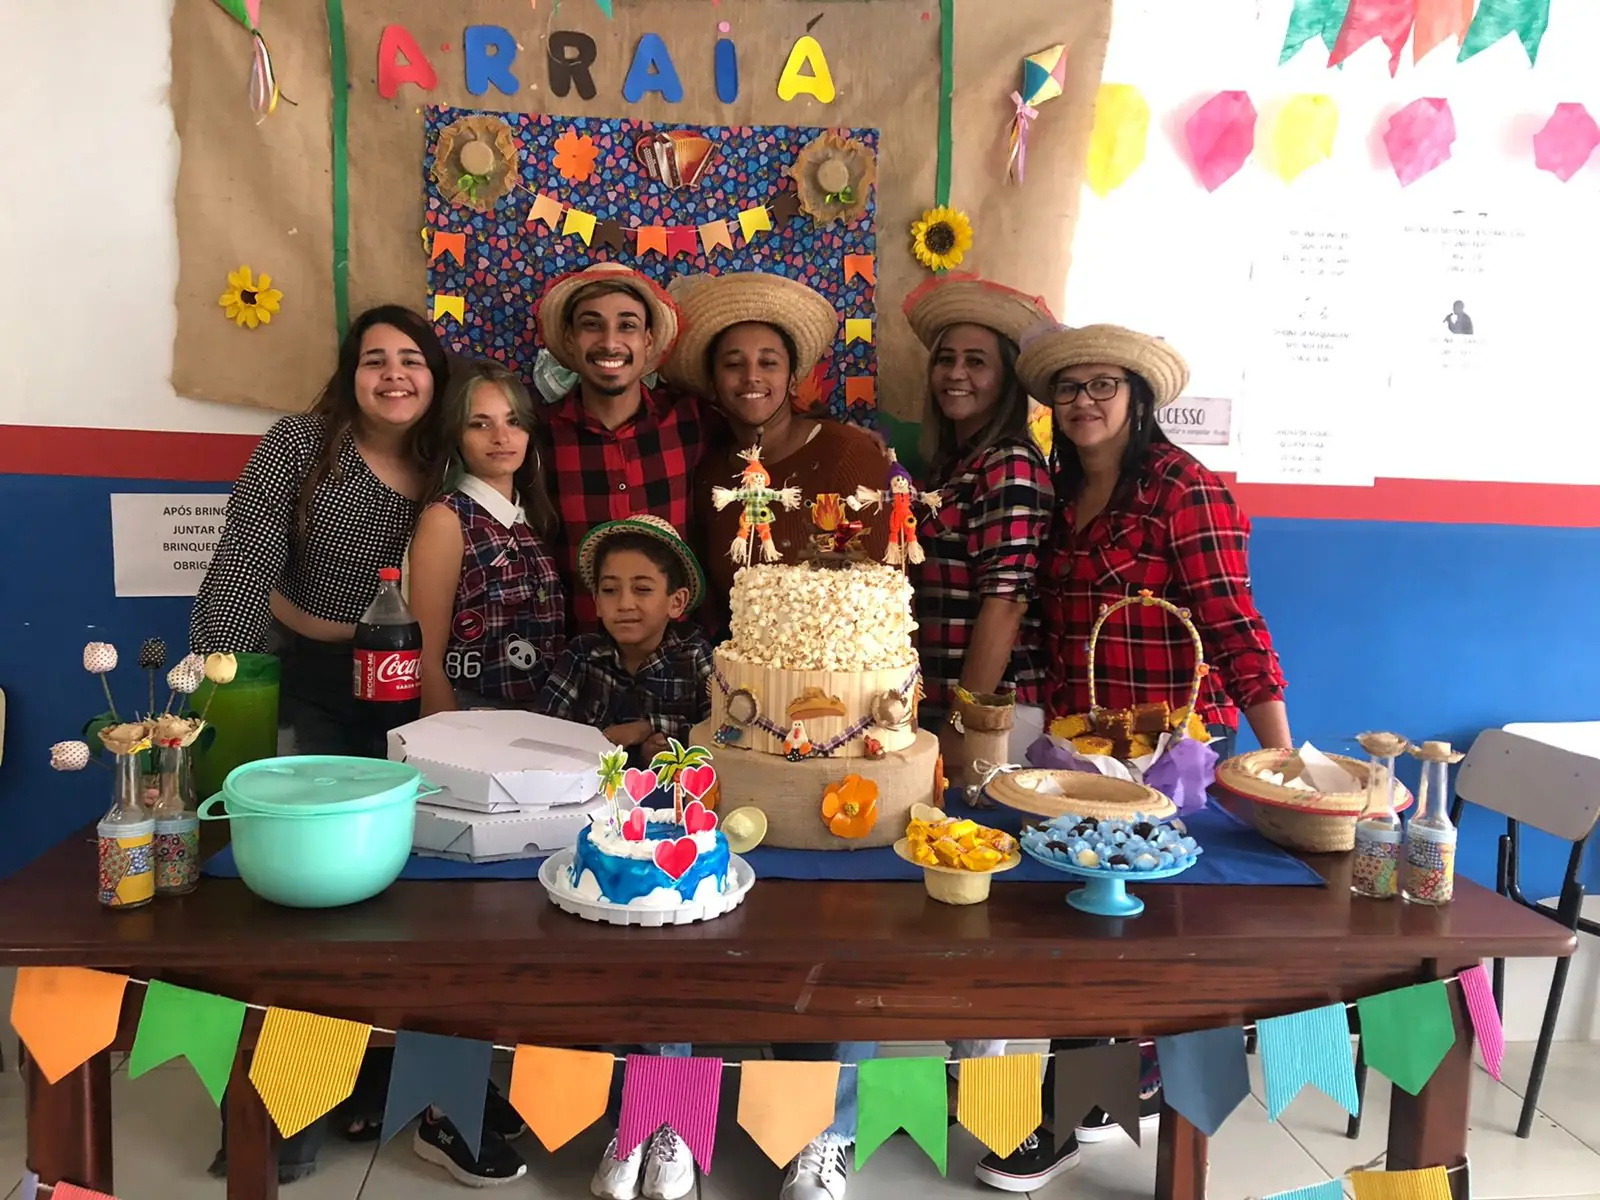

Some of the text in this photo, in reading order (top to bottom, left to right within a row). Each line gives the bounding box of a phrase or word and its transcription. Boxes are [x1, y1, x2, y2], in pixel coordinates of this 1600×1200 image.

[163, 505, 192, 516] APÓS
[173, 525, 215, 535] JUNTAR
[173, 561, 208, 570] OBRIG
[445, 651, 481, 678] 86
